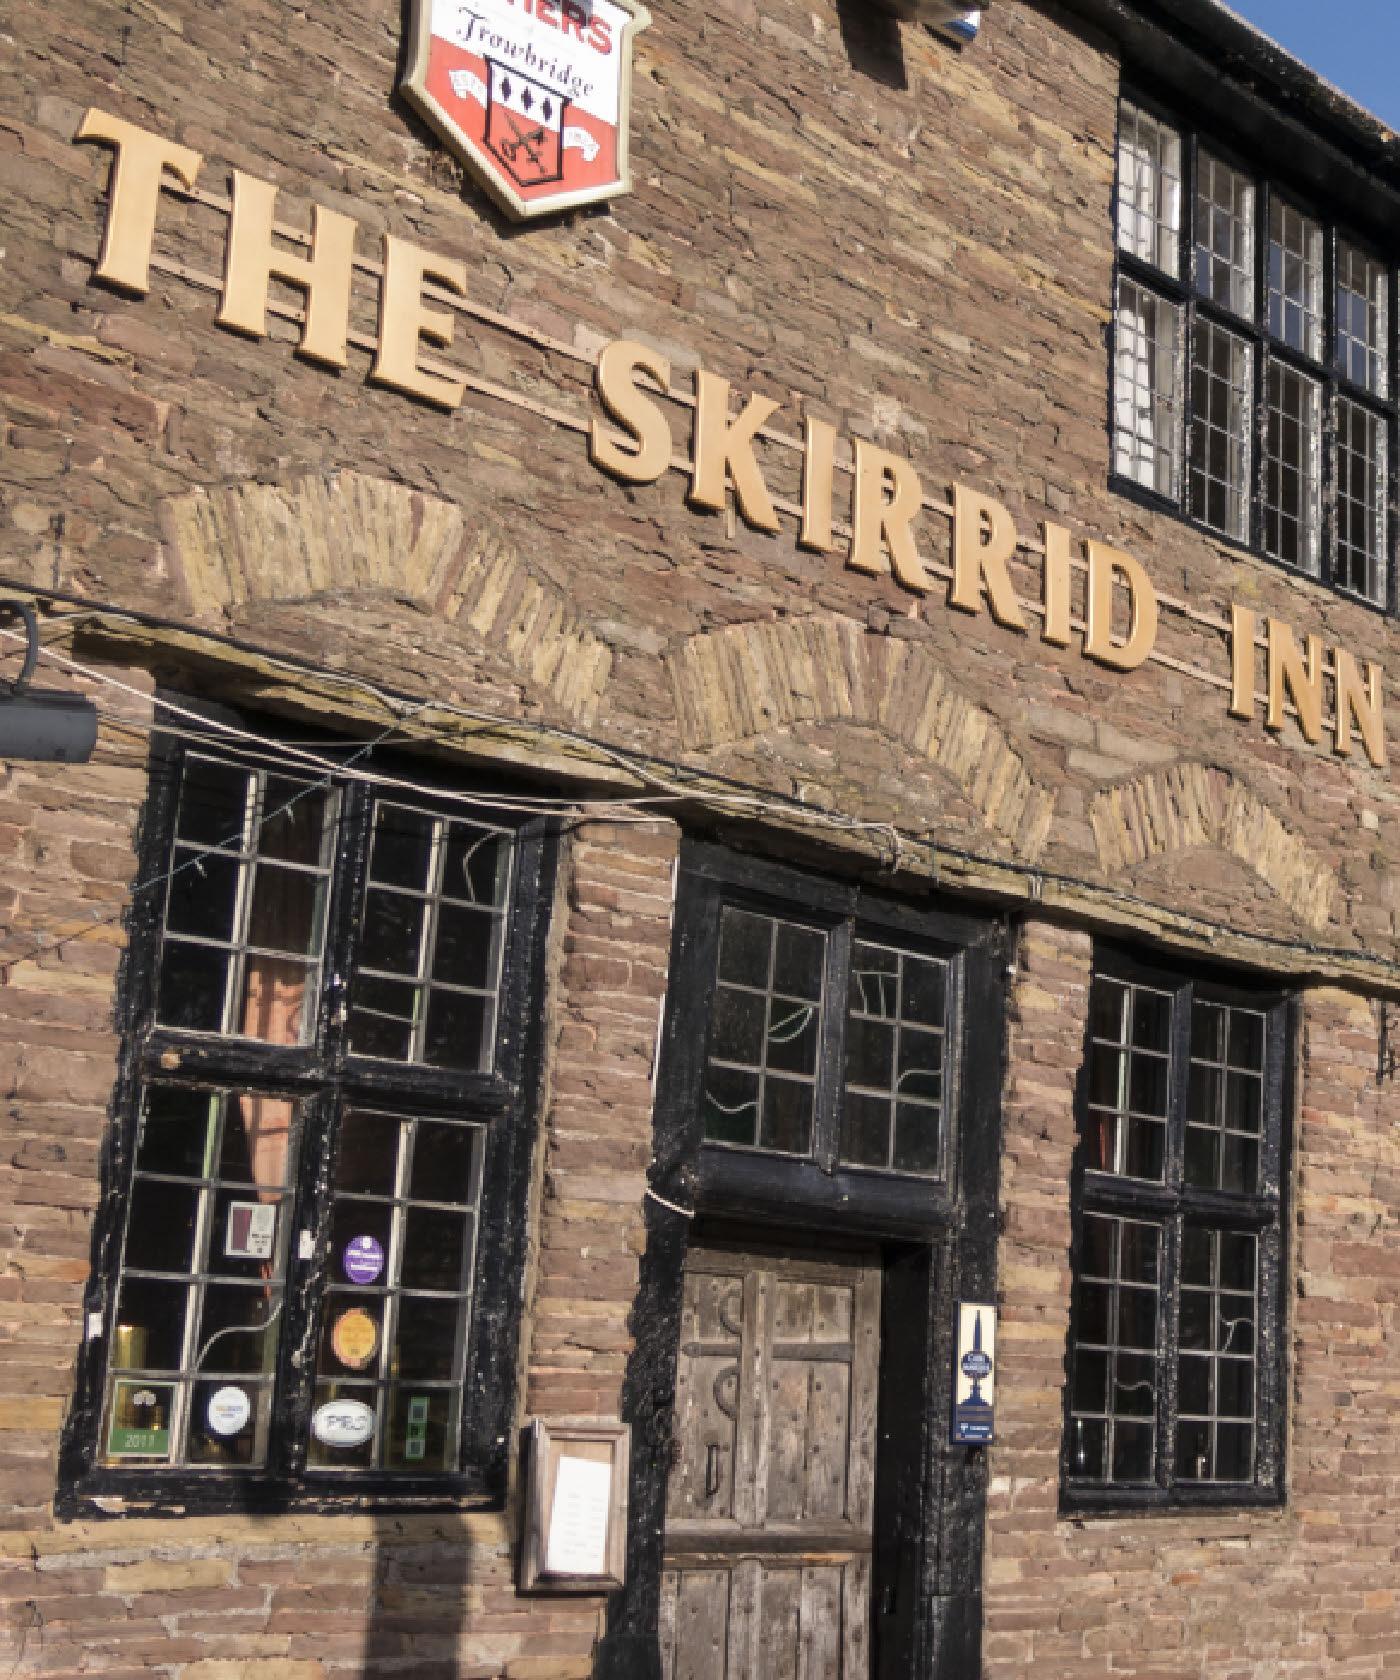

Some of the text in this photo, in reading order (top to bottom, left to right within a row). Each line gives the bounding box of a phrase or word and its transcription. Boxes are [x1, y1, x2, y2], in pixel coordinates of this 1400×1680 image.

[456, 7, 594, 97] Trowbridge
[75, 107, 1386, 768] THE SKIRRID INN
